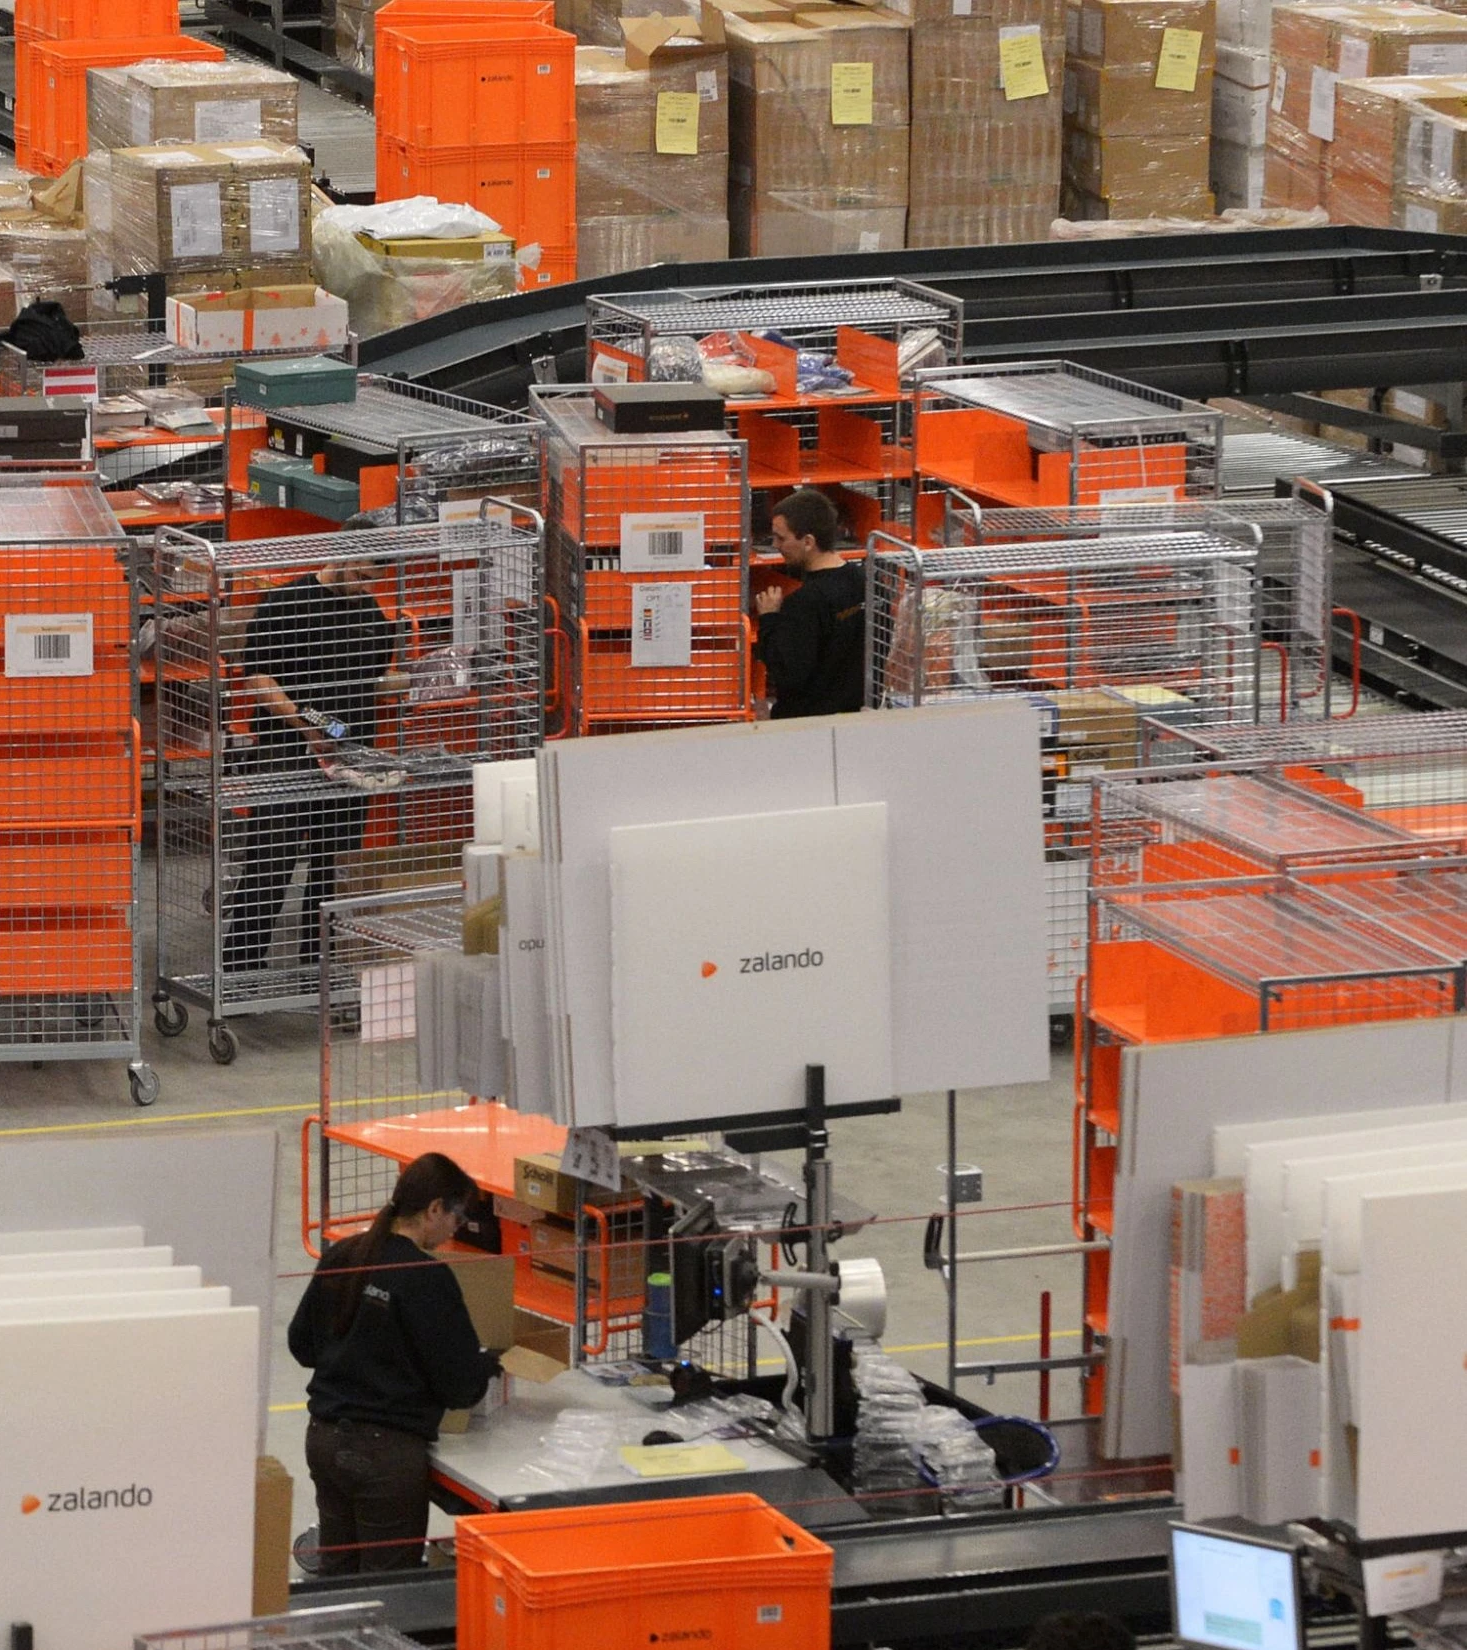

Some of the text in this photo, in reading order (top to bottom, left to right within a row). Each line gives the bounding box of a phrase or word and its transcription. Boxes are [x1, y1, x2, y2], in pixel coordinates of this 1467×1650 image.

[739, 948, 824, 974] zalando
[47, 1483, 153, 1513] zalando
[660, 1629, 713, 1642] zalando
